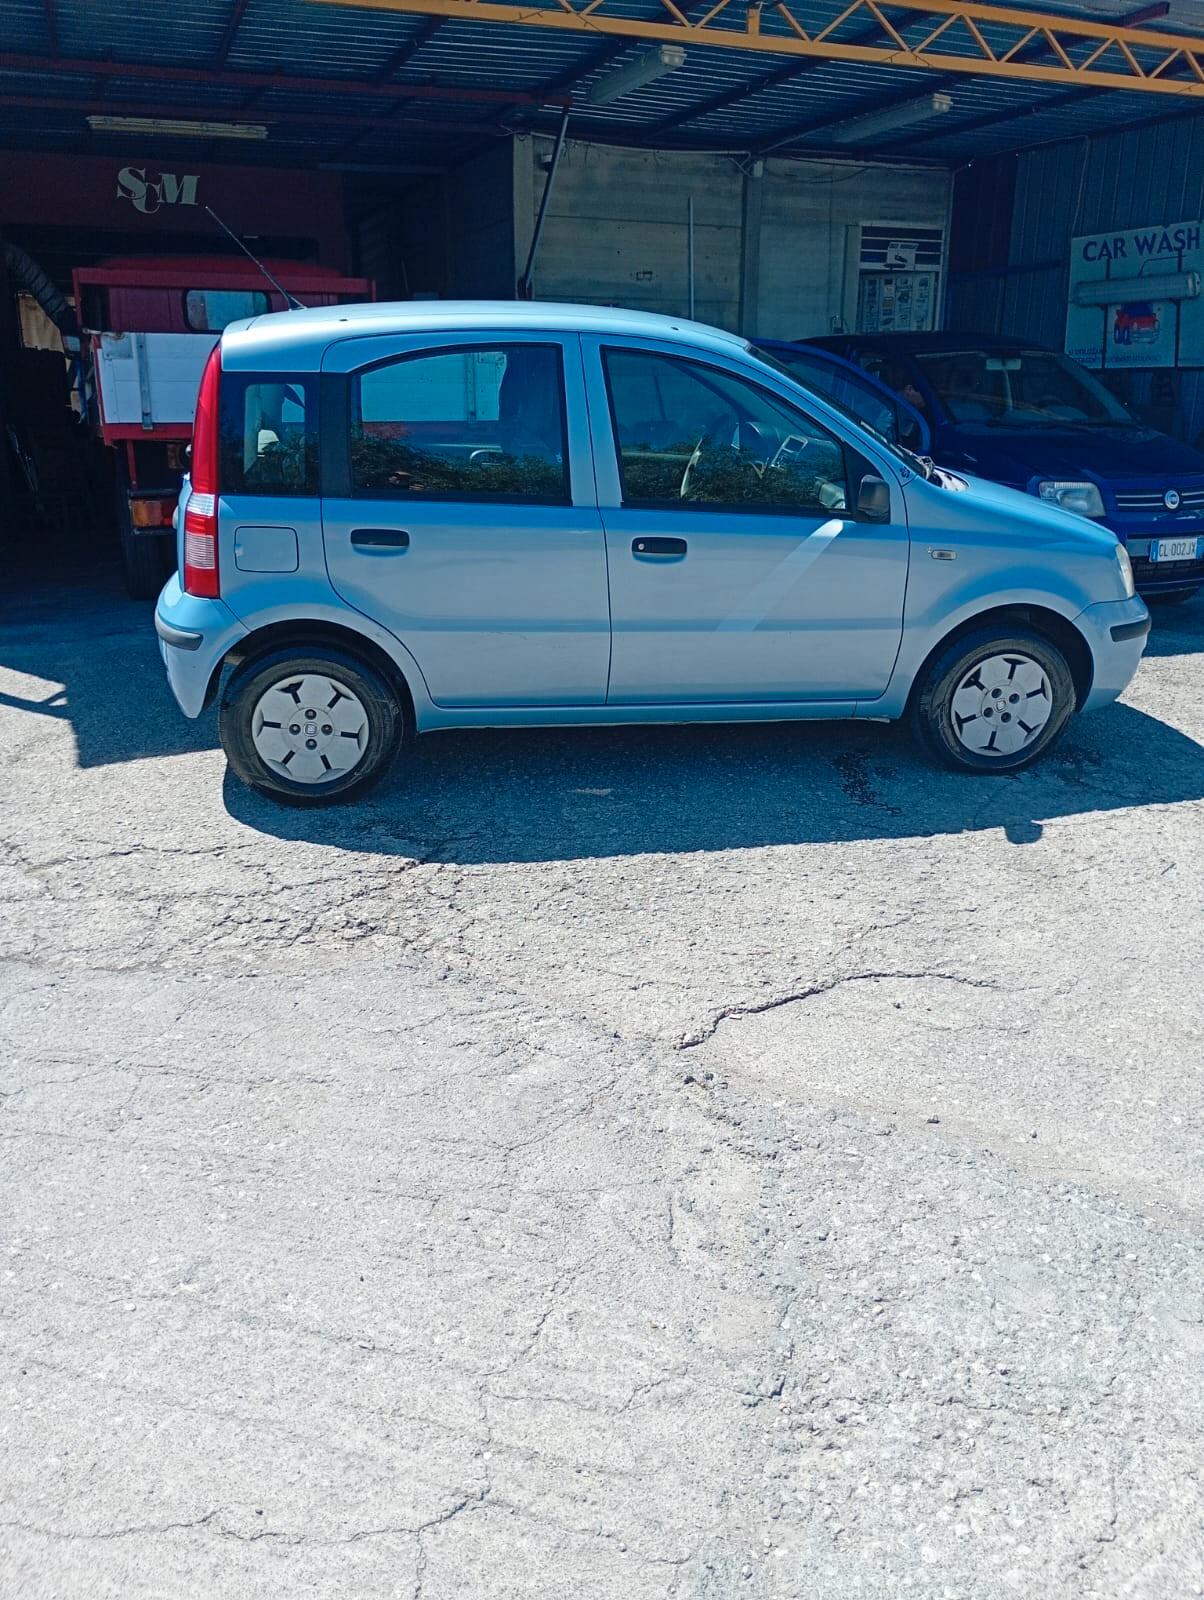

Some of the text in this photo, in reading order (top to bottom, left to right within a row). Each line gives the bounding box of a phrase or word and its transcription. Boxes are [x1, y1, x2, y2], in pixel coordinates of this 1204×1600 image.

[117, 167, 200, 214] SCM
[1082, 227, 1200, 262] CAR WASH
